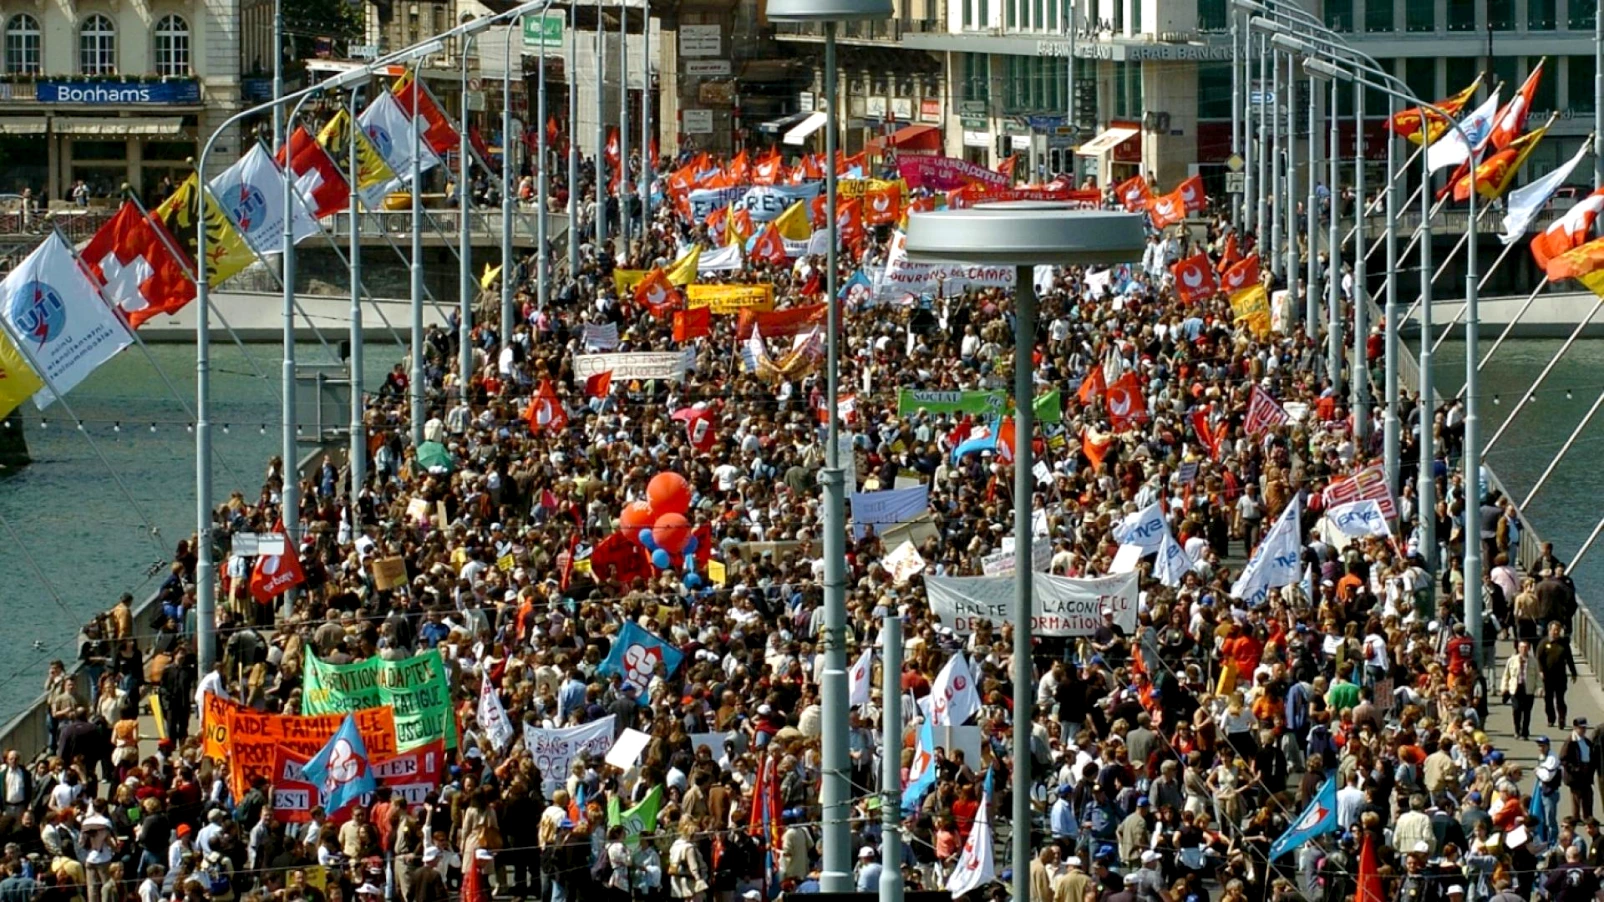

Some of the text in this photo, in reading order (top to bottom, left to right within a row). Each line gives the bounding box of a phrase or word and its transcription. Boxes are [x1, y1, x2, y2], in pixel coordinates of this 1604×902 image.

[1131, 47, 1169, 60] ARAB
[58, 85, 149, 101] Bonhams
[969, 267, 1012, 283] CAMPS
[914, 392, 957, 402] SOCIAL
[955, 602, 1006, 616] HALTE
[393, 684, 443, 715] FATIGUE
[234, 716, 271, 736] AIDE
[274, 793, 307, 808] EST
